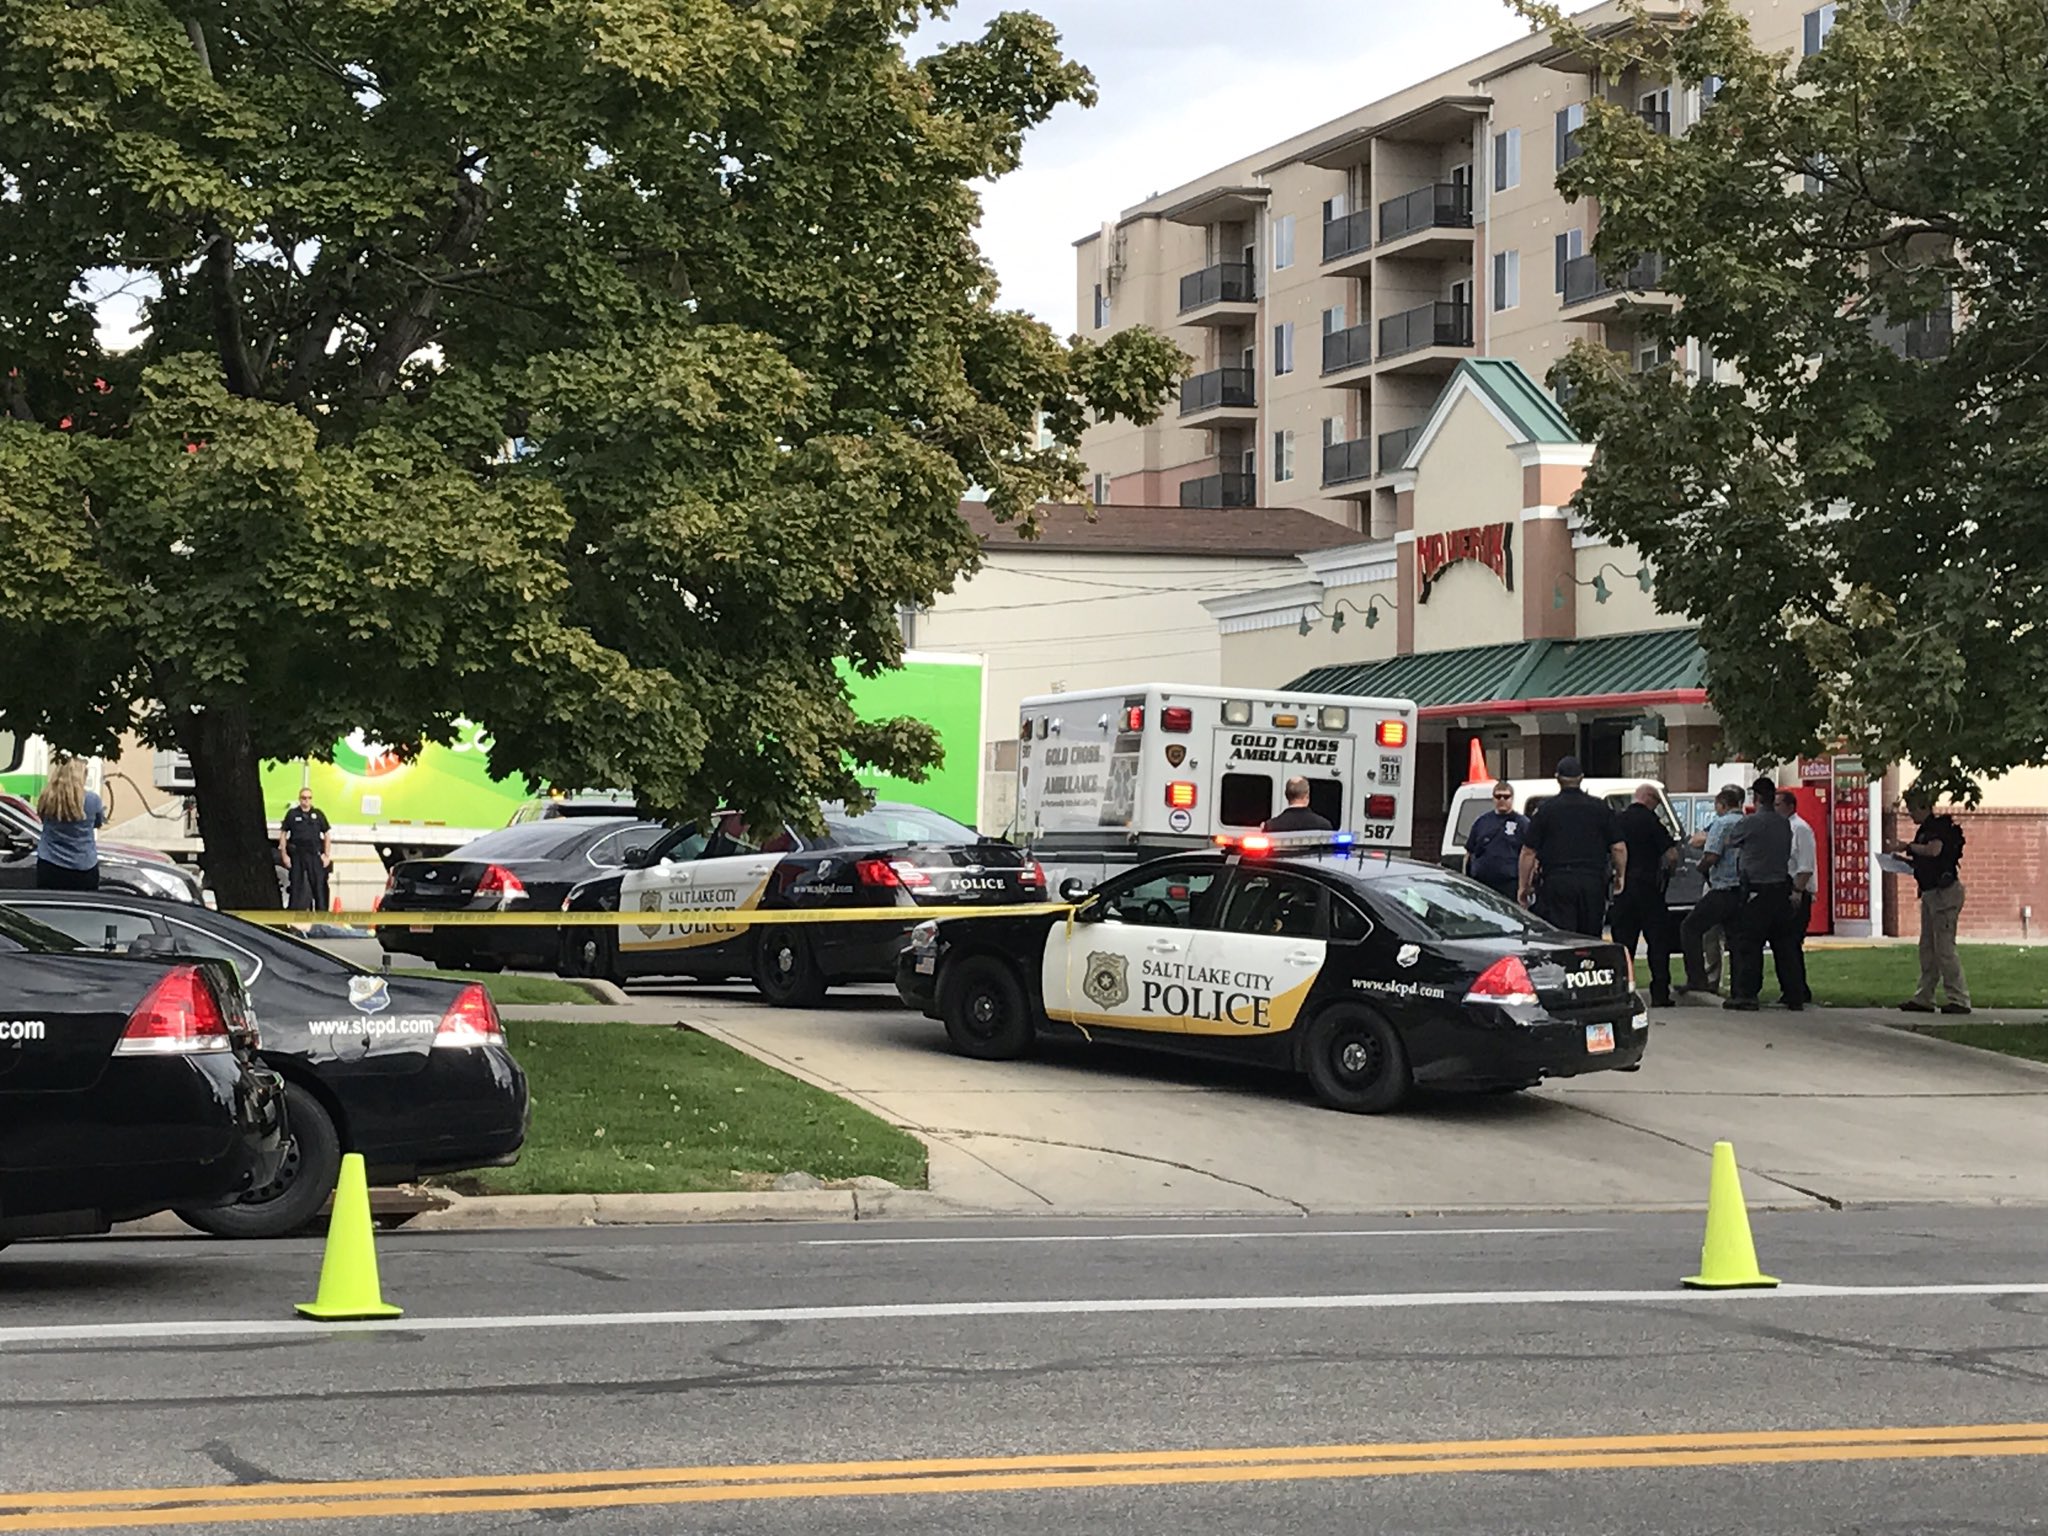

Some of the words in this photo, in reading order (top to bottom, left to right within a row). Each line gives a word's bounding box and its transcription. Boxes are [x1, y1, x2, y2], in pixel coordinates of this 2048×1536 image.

[1416, 522, 1514, 604] MAVERIK
[1231, 734, 1277, 748] GOLD
[1283, 737, 1340, 753] CROSS
[1045, 747, 1069, 766] GOLD
[1070, 745, 1101, 764] CROSS
[1230, 748, 1337, 766] AMBULANCE
[1381, 763, 1400, 774] 911
[1044, 774, 1099, 795] AMBULANCE
[1364, 824, 1394, 840] 587
[950, 878, 1005, 890] POLICE
[668, 890, 691, 905] SALT
[691, 889, 715, 904] LAKE
[716, 888, 737, 903] CITY
[1142, 959, 1184, 979] SALT
[1187, 965, 1231, 986] LAKE
[1234, 971, 1274, 991] CITY
[1565, 969, 1613, 989] POLICE
[1352, 979, 1444, 999] www.slcpd.com
[1142, 980, 1271, 1028] POLICE
[308, 1016, 434, 1038] www.slcpd.com
